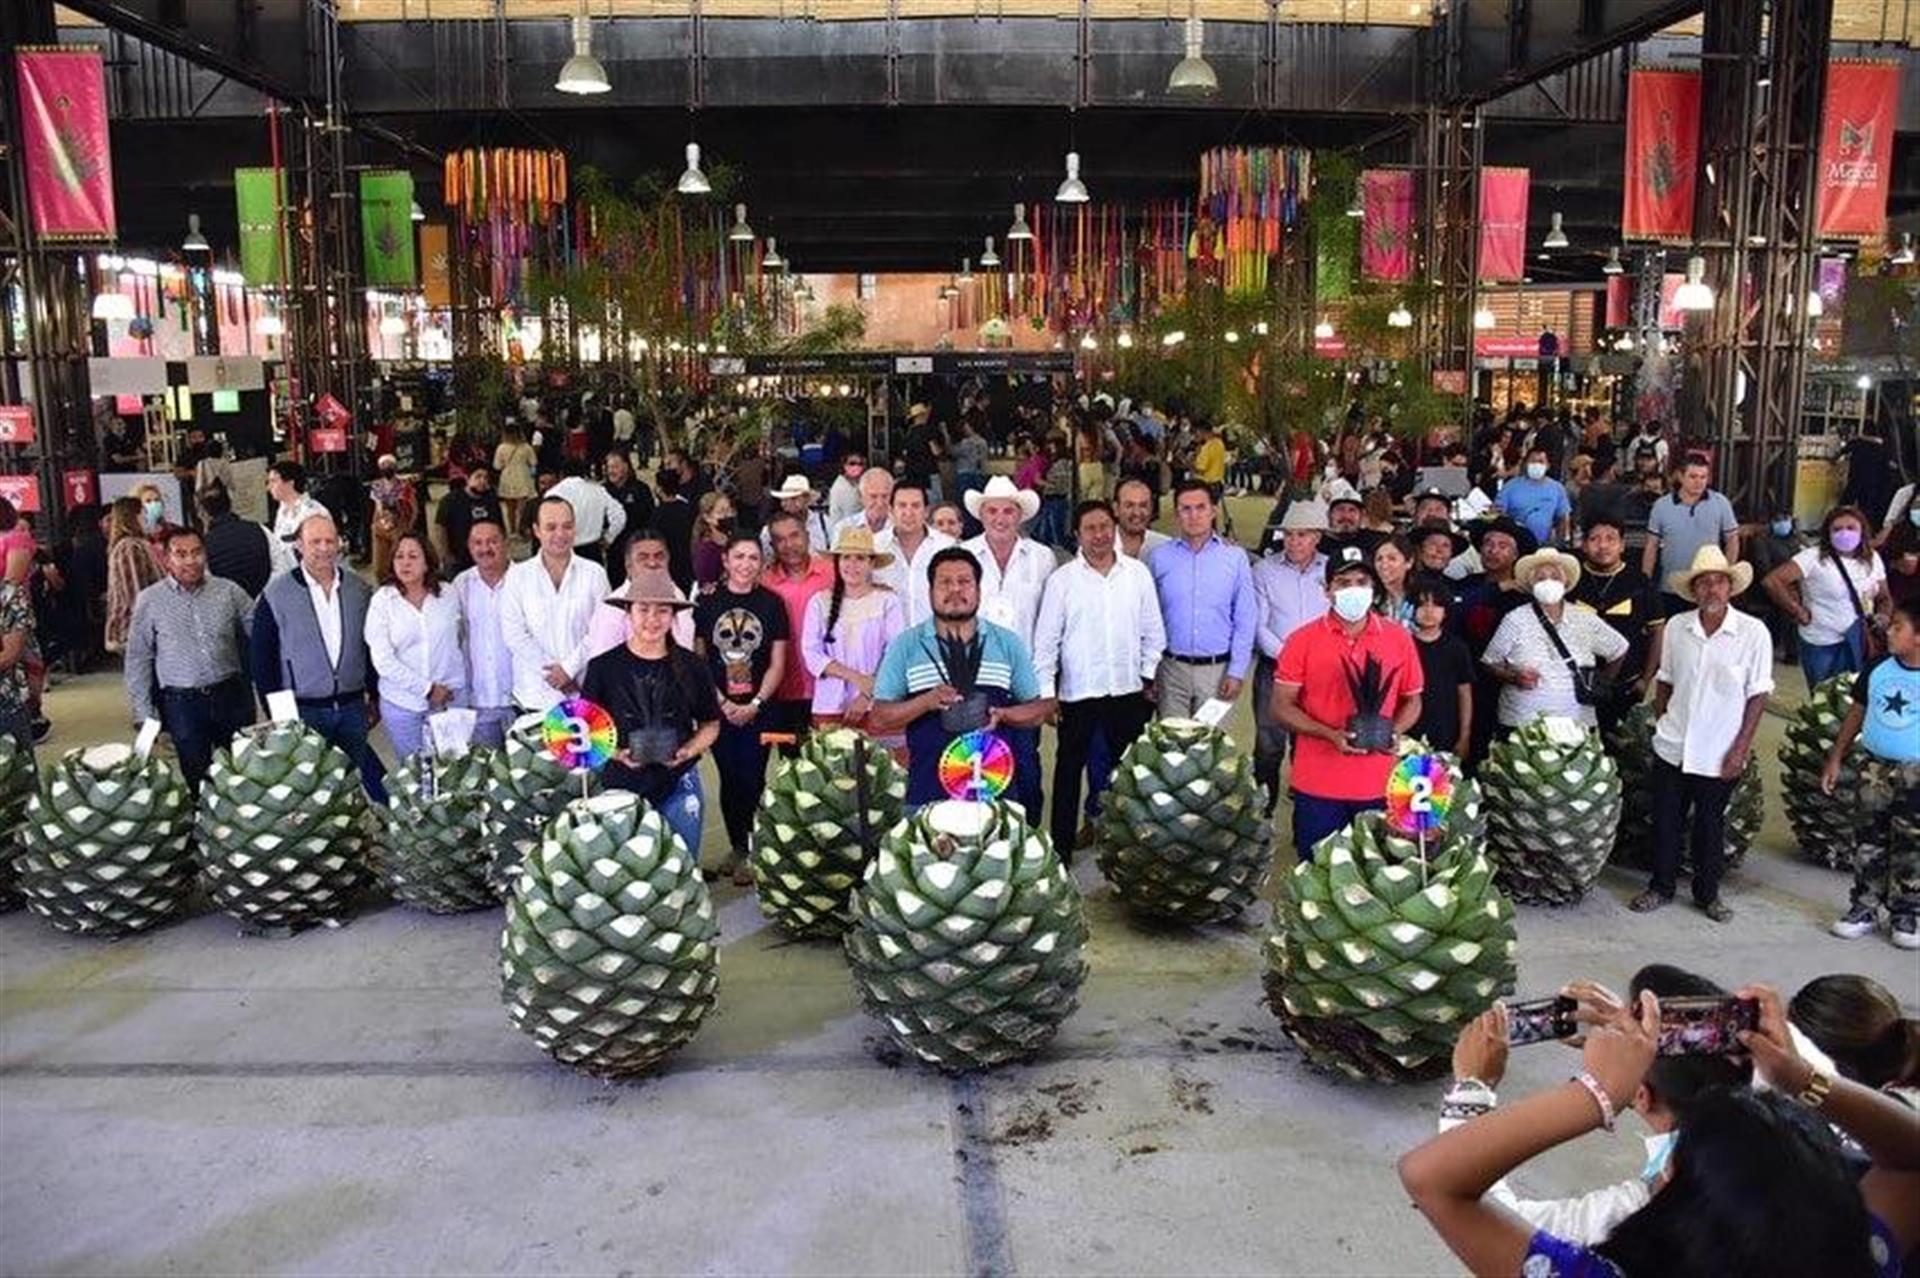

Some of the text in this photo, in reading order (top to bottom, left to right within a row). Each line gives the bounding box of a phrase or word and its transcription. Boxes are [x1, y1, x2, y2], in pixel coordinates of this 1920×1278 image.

[564, 716, 592, 754] 3
[966, 751, 989, 788] 1
[1409, 775, 1433, 813] 2
